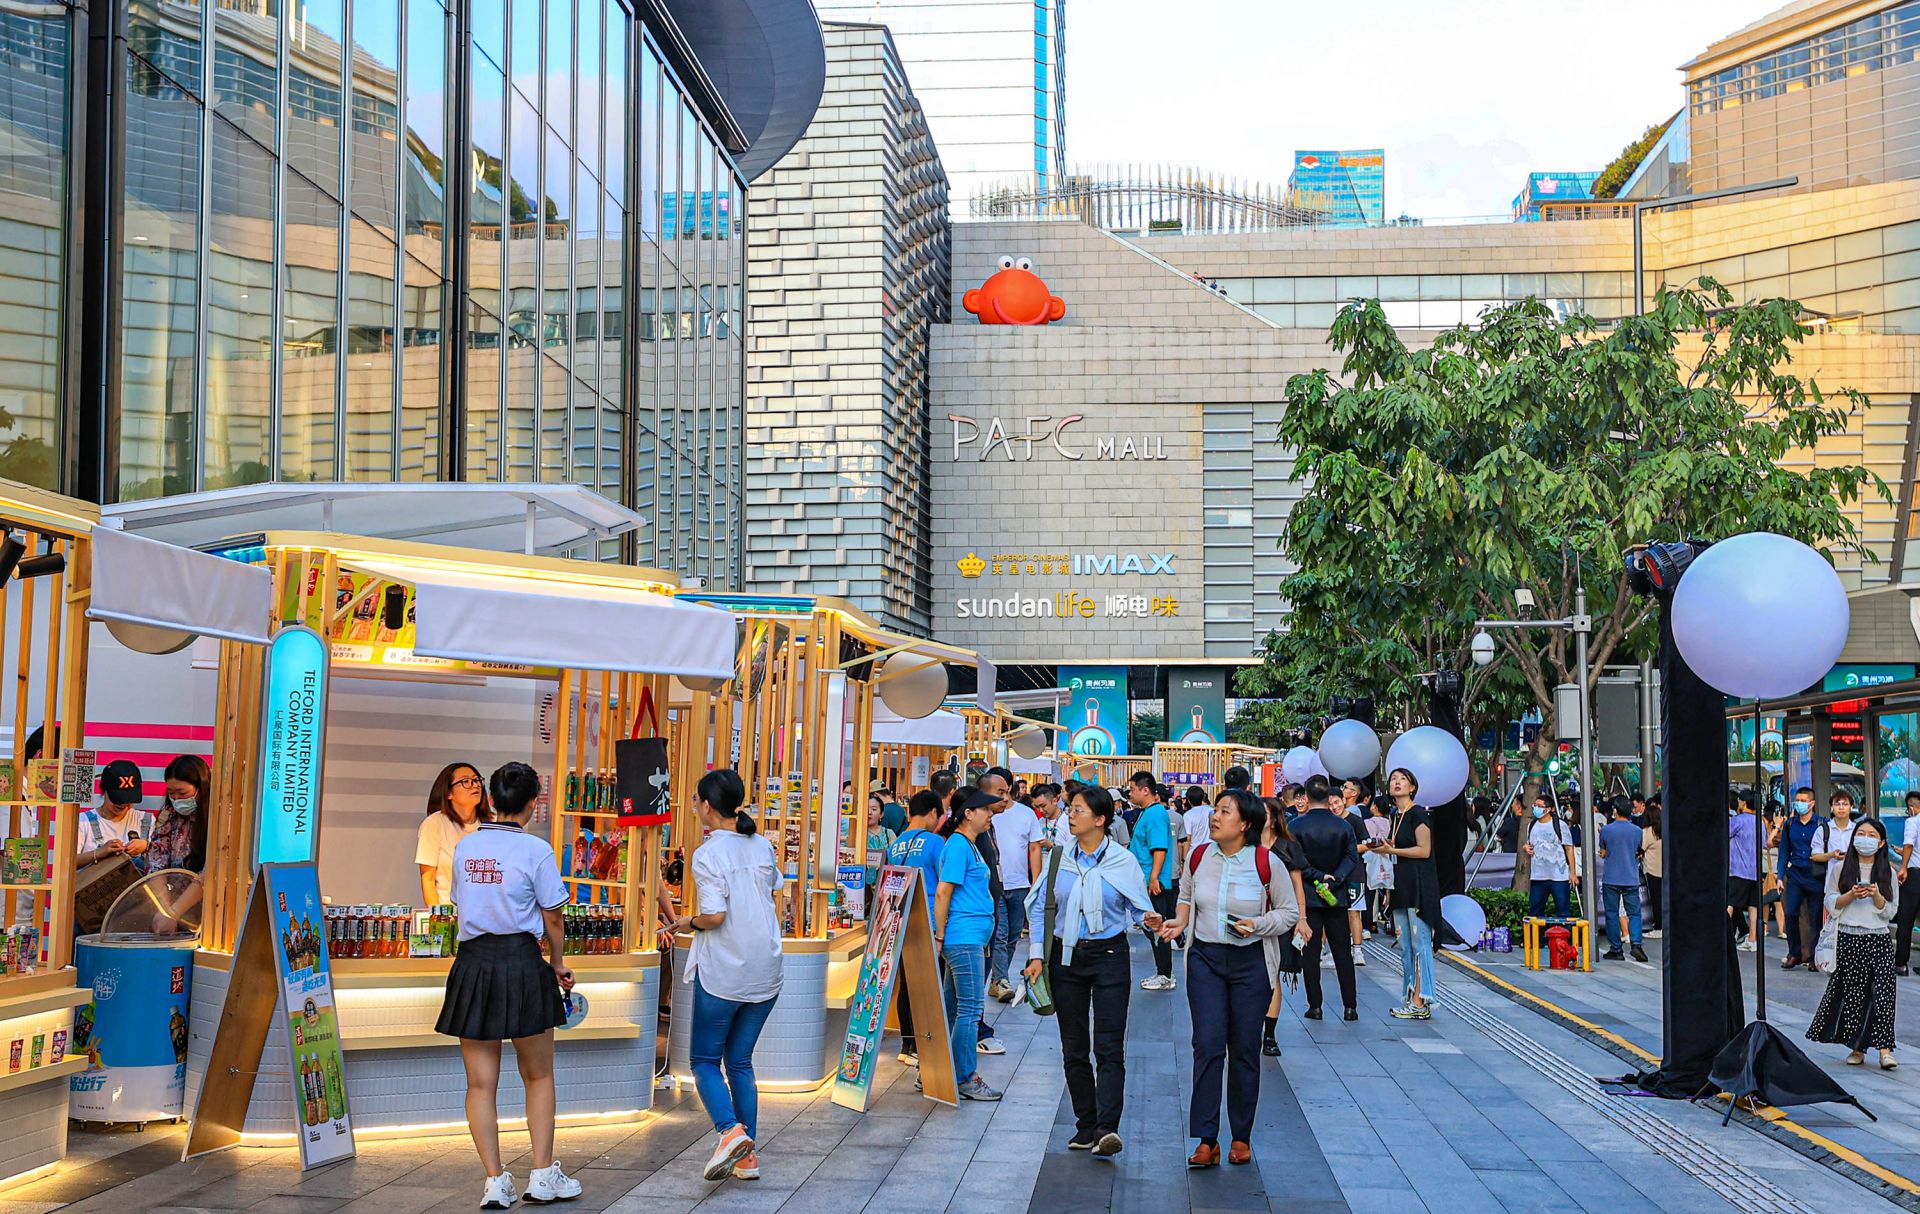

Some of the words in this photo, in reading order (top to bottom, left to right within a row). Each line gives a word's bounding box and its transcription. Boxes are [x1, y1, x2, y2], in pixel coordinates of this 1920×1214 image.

[948, 413, 1083, 462] PAFC
[1097, 436, 1168, 461] MALL
[991, 553, 1028, 562] EMPEROR
[1033, 553, 1070, 562] CINEMAS
[991, 563, 1070, 576] 英皇电影城
[1074, 553, 1176, 576] IMAX
[1105, 594, 1180, 618] 顺电味
[302, 670, 316, 725] TELFORD
[286, 690, 301, 760] COMPANY
[270, 710, 284, 791] 汇泉国际有限公司
[282, 763, 296, 813] LIMITED
[294, 729, 313, 835] INTERNATIONAL
